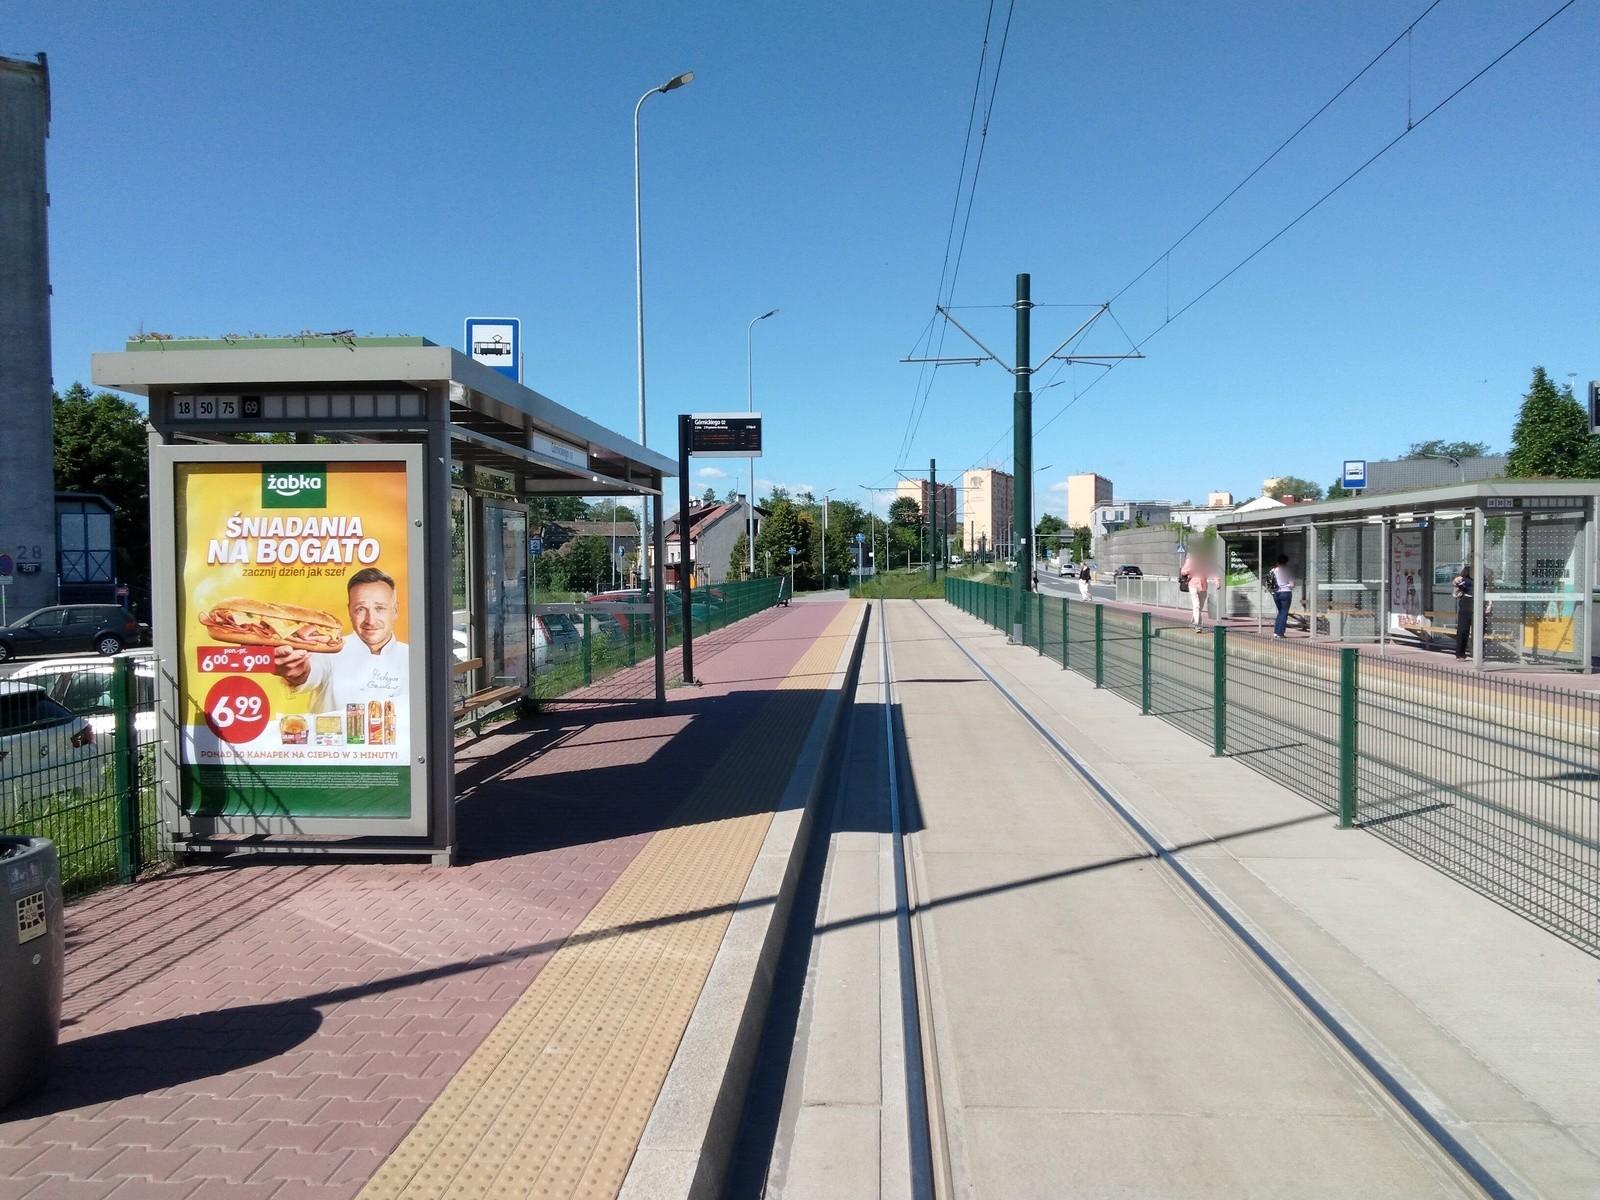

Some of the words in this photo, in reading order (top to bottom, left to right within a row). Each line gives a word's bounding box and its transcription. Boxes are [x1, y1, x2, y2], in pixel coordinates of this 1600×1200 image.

[179, 401, 191, 414] 18
[200, 401, 213, 414] 50
[222, 401, 235, 414] 75
[244, 400, 258, 414] 69
[267, 474, 321, 490] żabka
[225, 511, 364, 539] ŚNIADANIA
[16, 545, 42, 560] 28
[207, 538, 250, 565] NA
[256, 538, 380, 565] BOGATO
[242, 567, 276, 578] zacznij
[278, 566, 306, 577] dzień
[306, 567, 323, 578] jak
[324, 566, 346, 577] szef
[201, 751, 231, 759] PONAD
[247, 751, 289, 759] KANAPEK
[292, 751, 305, 759] NA
[307, 751, 340, 759] CIEPŁO
[342, 751, 351, 759] W
[353, 751, 358, 759] 3
[360, 751, 398, 759] MINUTY!
